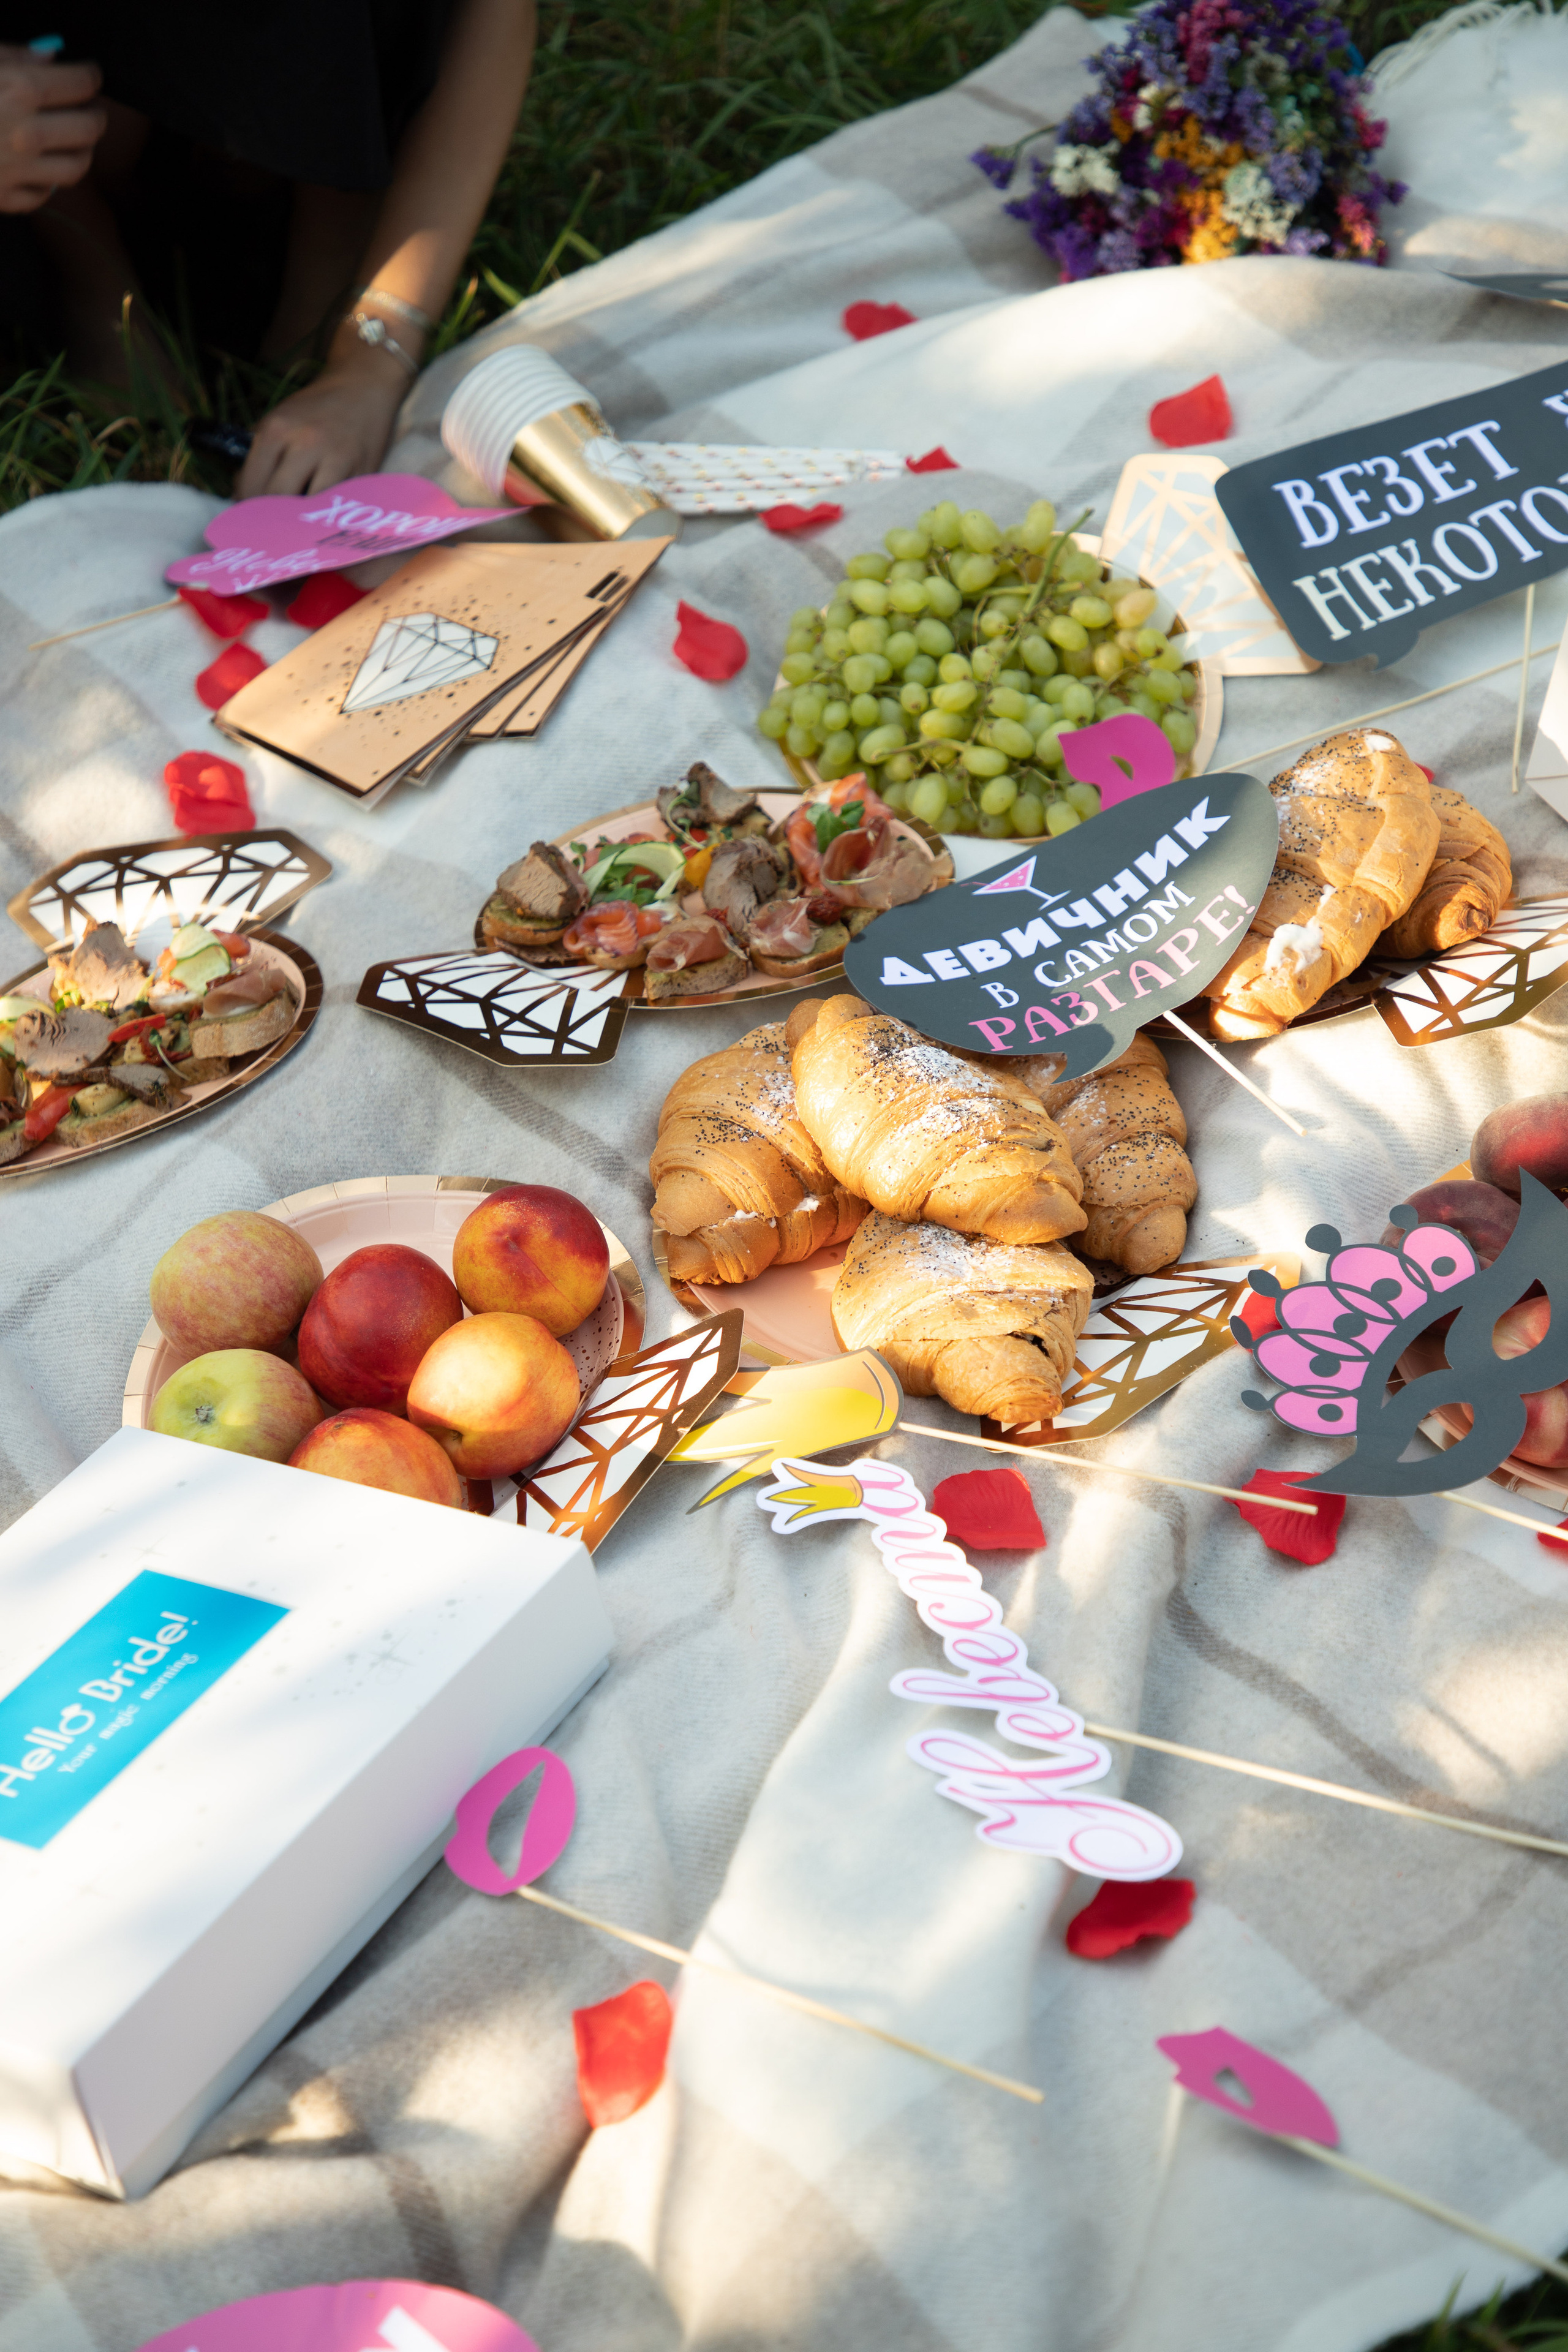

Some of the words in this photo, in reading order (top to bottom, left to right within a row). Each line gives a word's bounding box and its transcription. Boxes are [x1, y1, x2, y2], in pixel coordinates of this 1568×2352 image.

[1272, 420, 1519, 548] ВЕЗЕТ
[1292, 472, 1568, 641] НЕКОТО
[880, 796, 1231, 986] ДЕВИЧНИК
[968, 884, 1256, 1052] РАЗГАРЕ!
[981, 982, 1020, 1009] В
[1033, 881, 1196, 988] САМОМ
[0, 1703, 97, 1798] Hello
[79, 1611, 198, 1702] Bride!
[58, 1743, 97, 1774] Your
[99, 1703, 140, 1740] magic
[140, 1653, 199, 1700] morning
